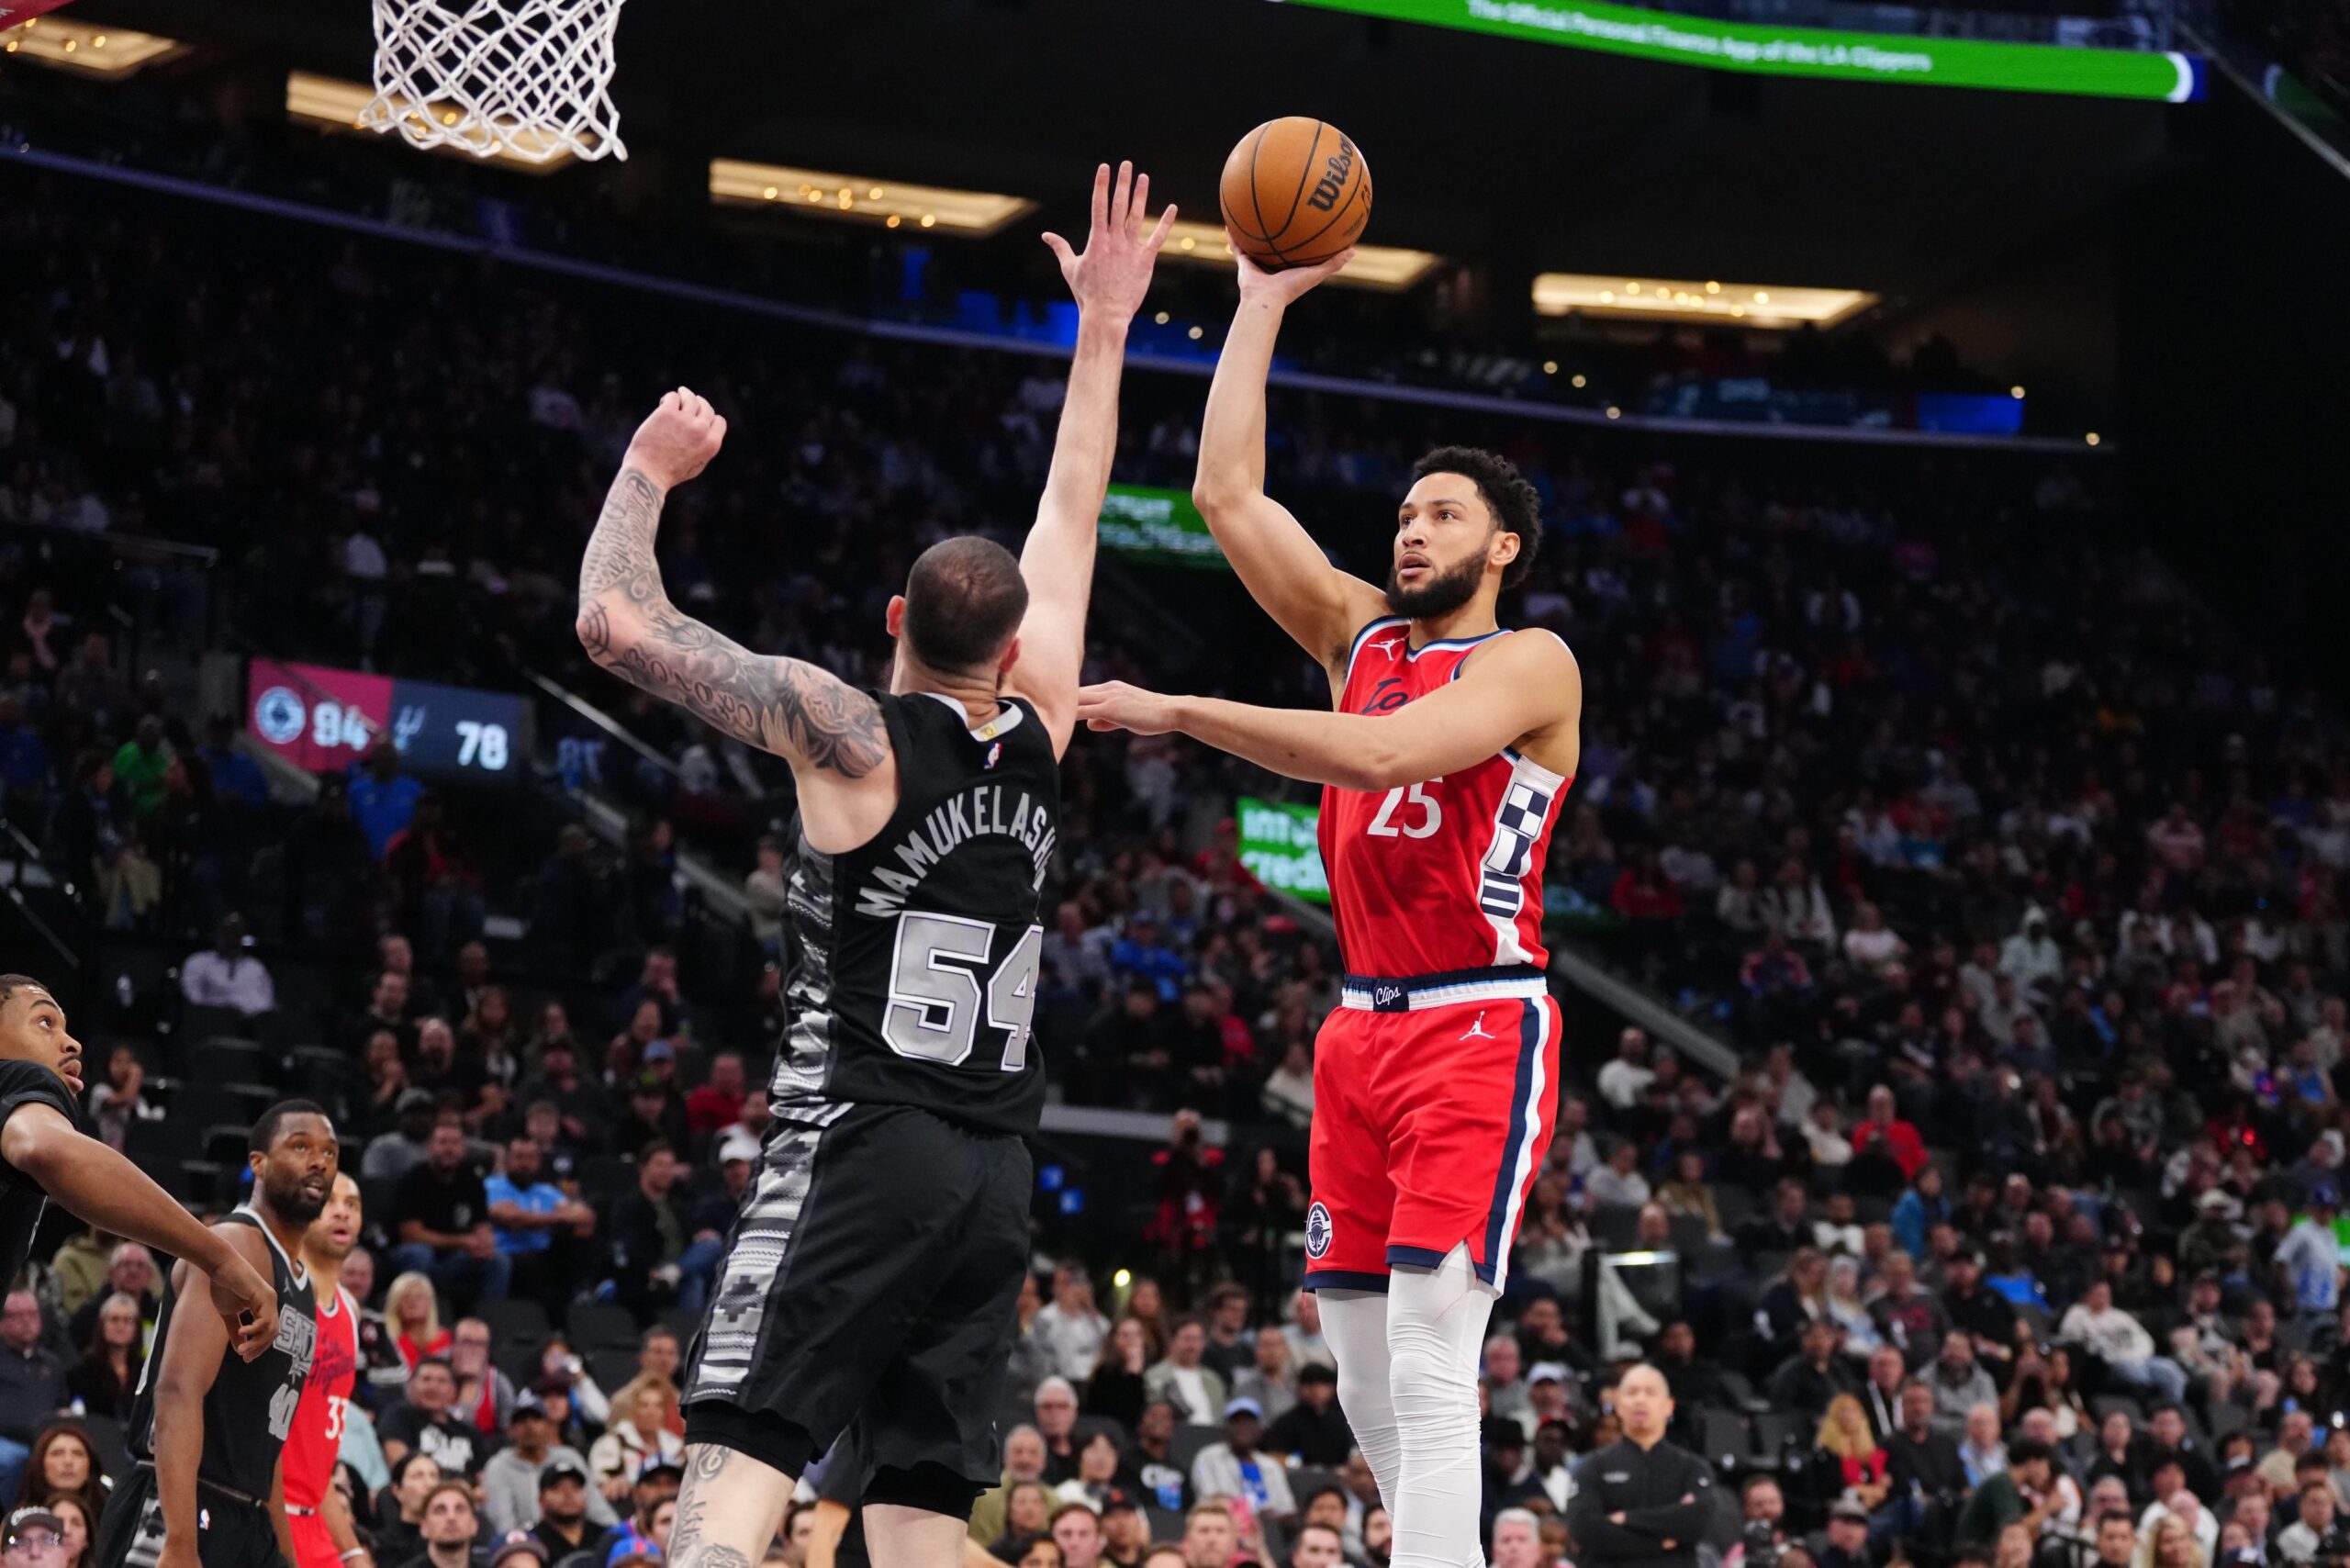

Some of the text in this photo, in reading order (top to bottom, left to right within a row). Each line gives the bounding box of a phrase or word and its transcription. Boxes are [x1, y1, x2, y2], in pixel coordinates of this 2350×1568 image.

[1468, 0, 1502, 20] The
[1505, 0, 1566, 30] Official
[1572, 11, 1646, 42] Personal
[1722, 34, 1757, 61] App
[1761, 38, 1785, 60] of
[1785, 39, 1817, 62] the
[1818, 43, 1846, 65] LA
[1849, 45, 1931, 72] Clippers
[1360, 678, 1419, 716] Lo
[456, 721, 508, 770] 78
[1367, 776, 1444, 840] 25
[881, 910, 1044, 1072] 54
[1376, 986, 1401, 1005] Clips
[268, 1383, 299, 1440] 40
